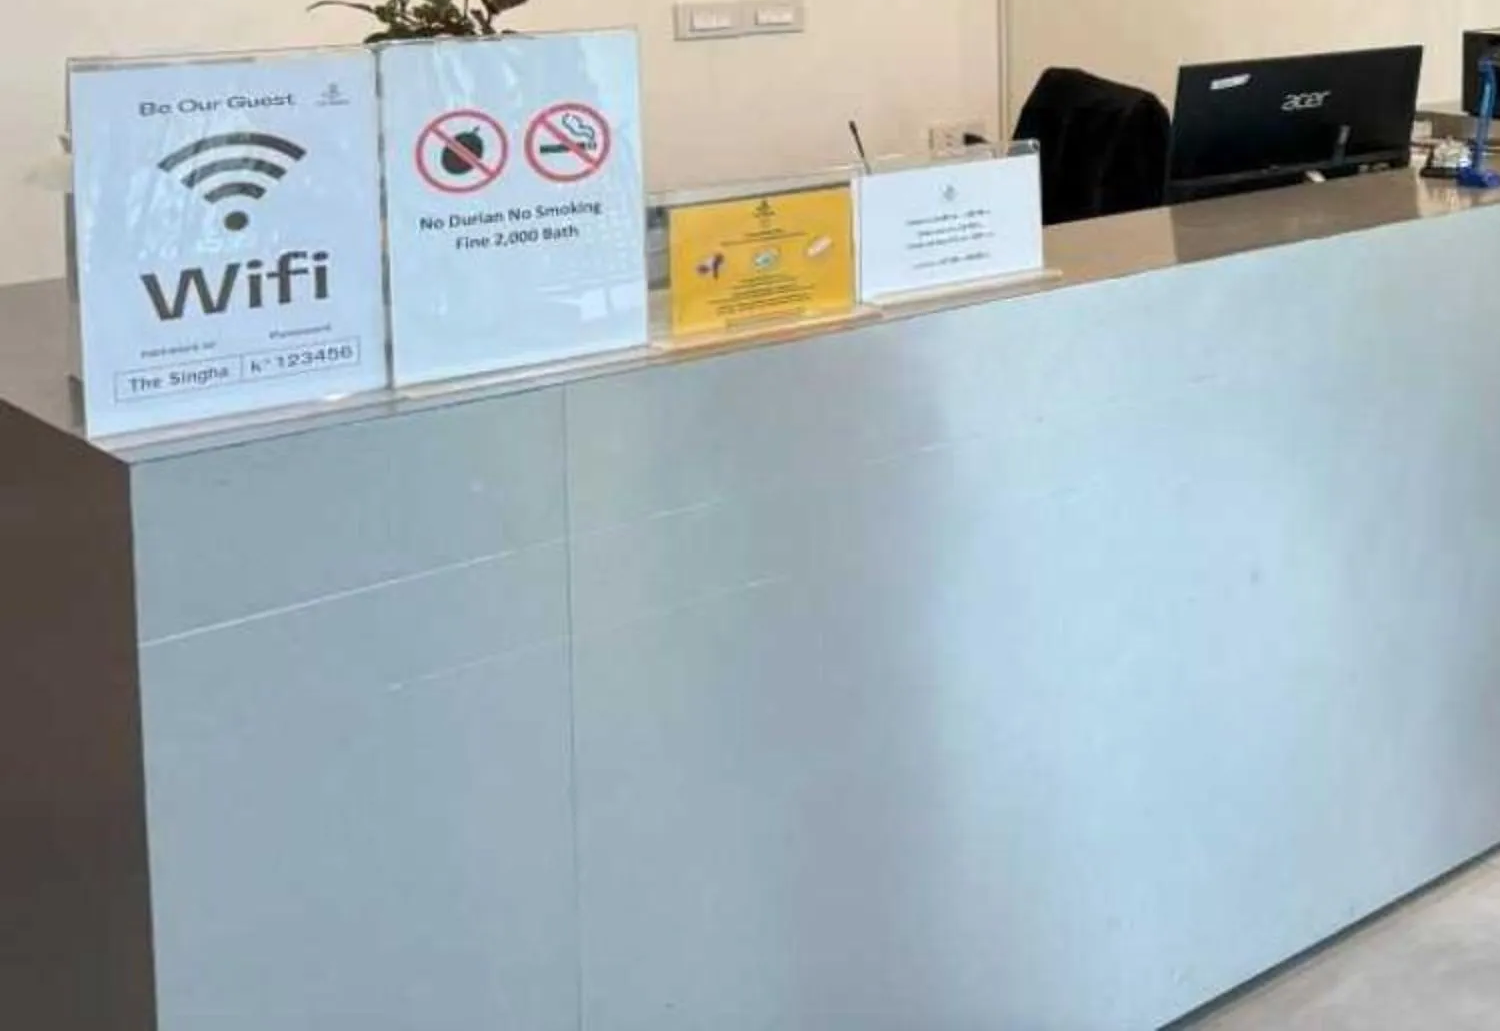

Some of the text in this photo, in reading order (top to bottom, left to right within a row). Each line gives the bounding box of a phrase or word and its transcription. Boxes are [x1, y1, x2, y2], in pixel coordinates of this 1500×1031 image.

[177, 97, 223, 114] Our
[226, 92, 296, 109] Guest
[1280, 89, 1331, 111] acer
[420, 200, 602, 231] No Durian No Smoking
[455, 223, 580, 250] Fine 2,000 Bath
[140, 250, 331, 322] Wifi
[129, 365, 230, 393] The Singha
